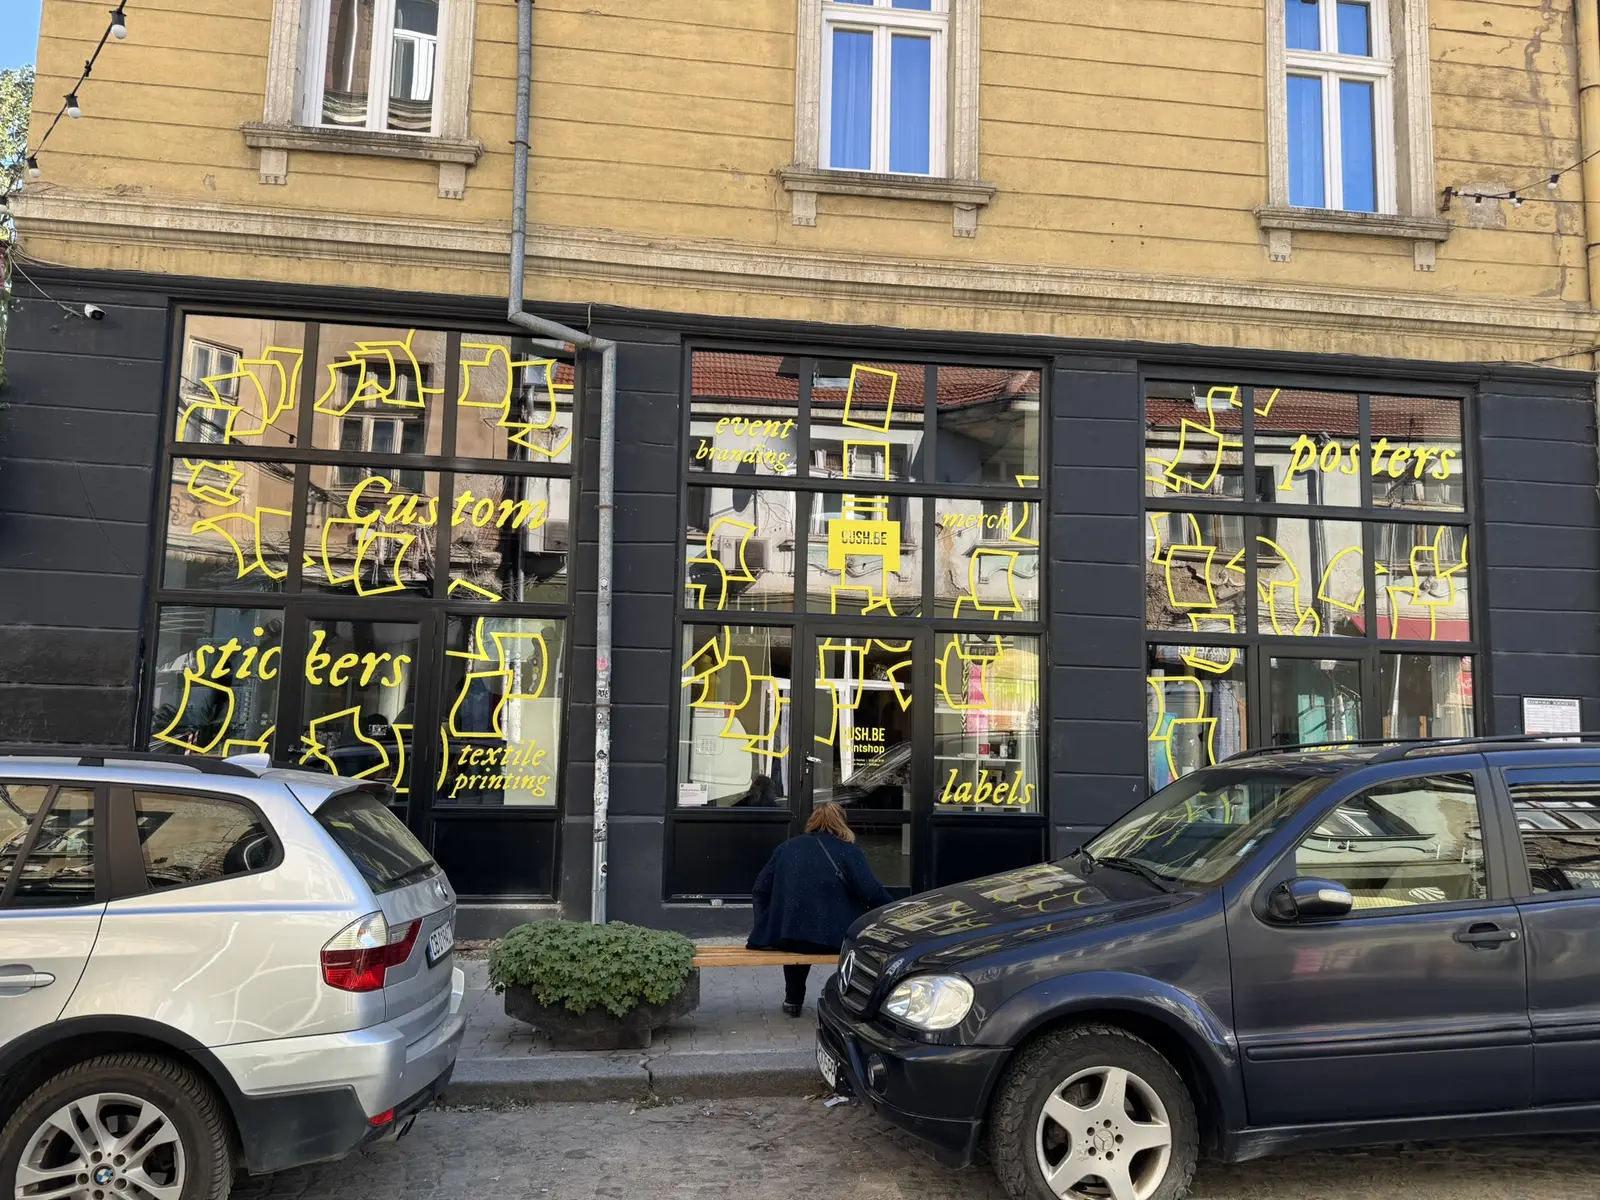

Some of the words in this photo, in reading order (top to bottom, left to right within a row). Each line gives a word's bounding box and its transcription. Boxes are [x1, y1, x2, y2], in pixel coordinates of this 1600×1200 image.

[715, 416, 795, 440] event
[695, 438, 790, 473] branding
[1277, 435, 1456, 492] posters
[346, 475, 548, 530] Custom
[941, 506, 1011, 531] merch
[184, 626, 412, 688] stickers
[457, 738, 547, 767] textile
[447, 767, 551, 799] printing
[940, 768, 1035, 806] labels
